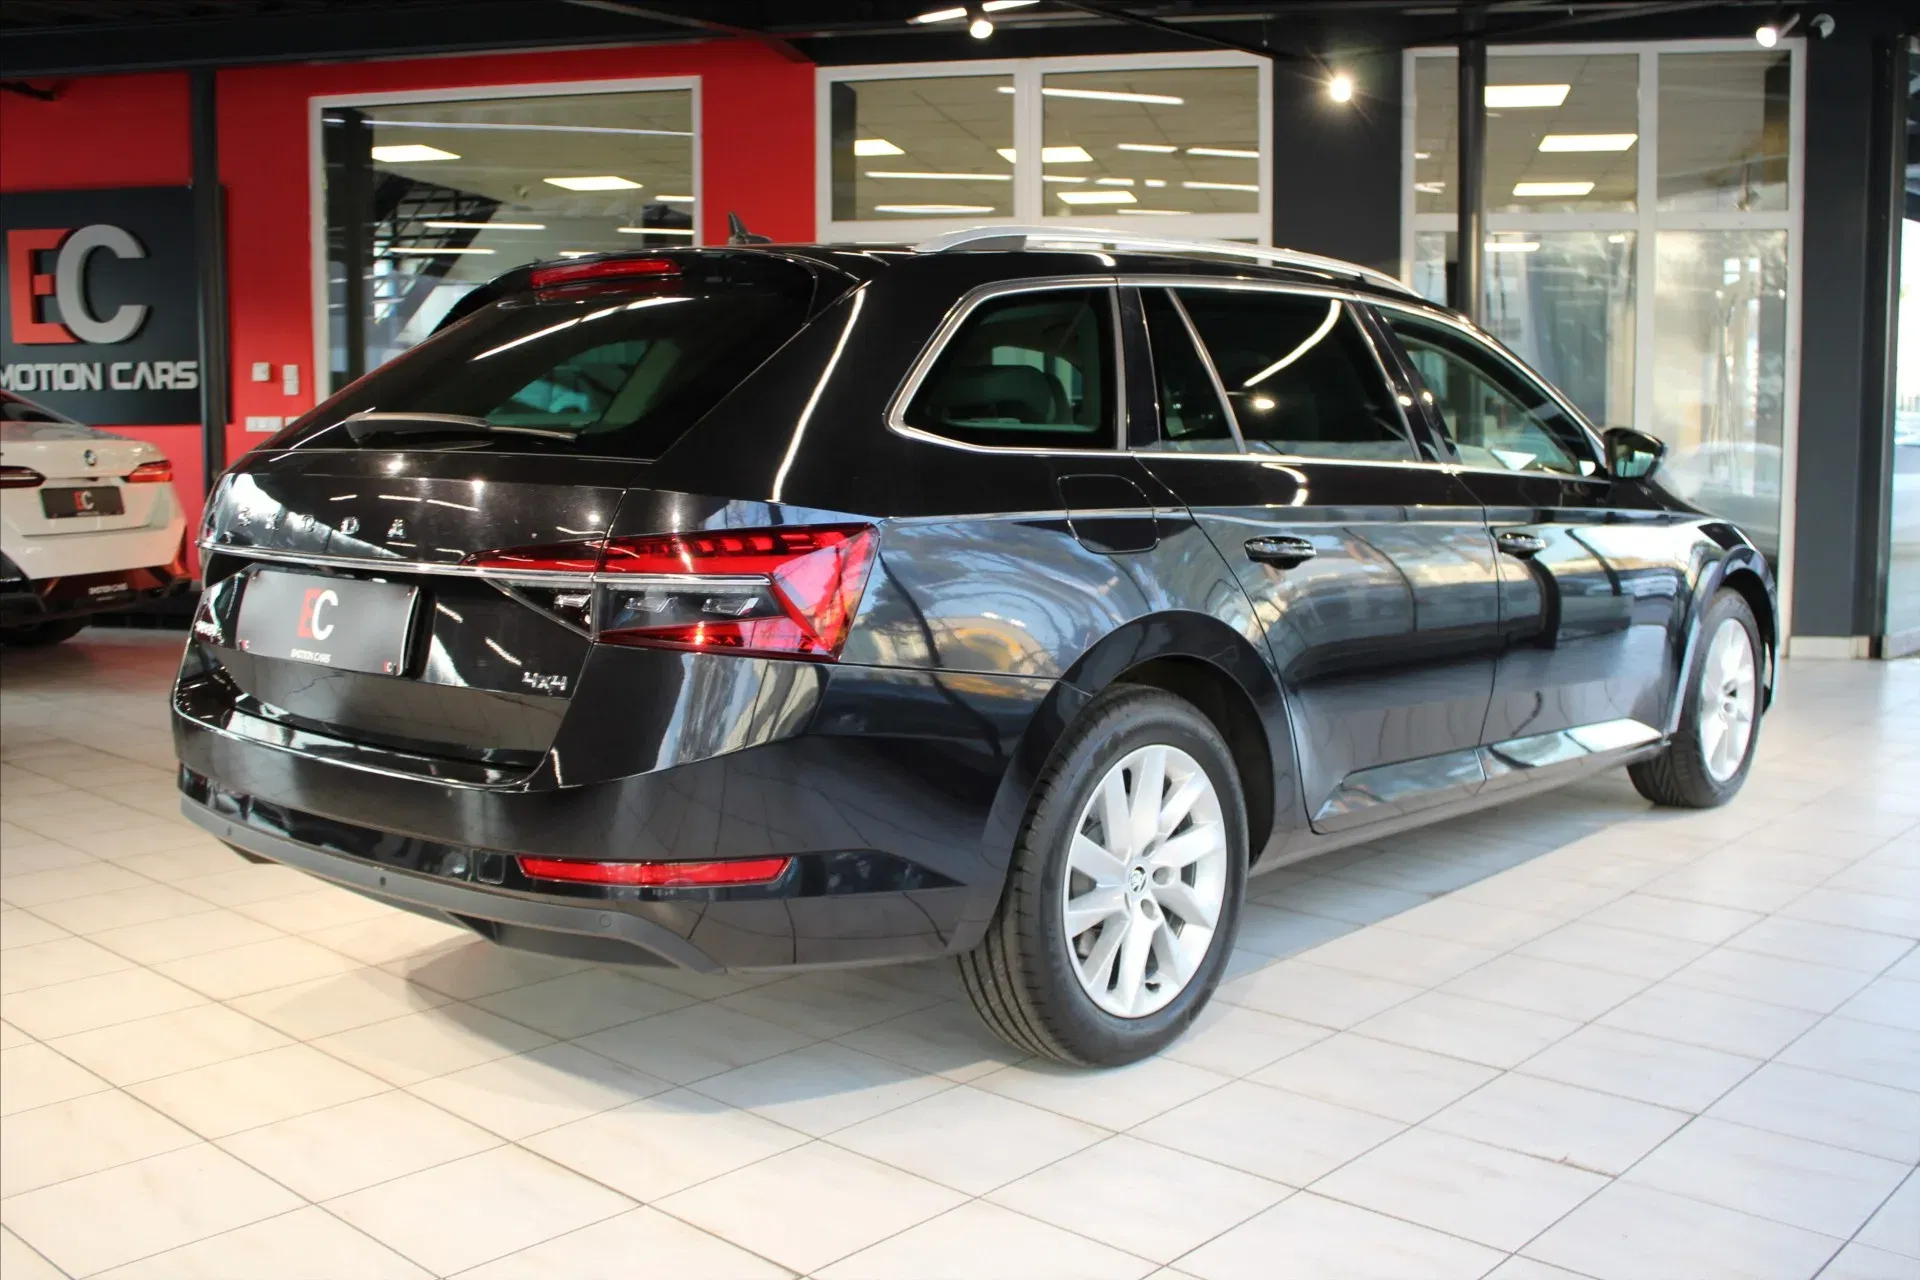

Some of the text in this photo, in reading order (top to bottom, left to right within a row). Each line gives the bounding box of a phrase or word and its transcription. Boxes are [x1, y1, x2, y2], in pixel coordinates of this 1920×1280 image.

[7, 224, 148, 344] EC
[110, 361, 199, 390] CARS
[297, 588, 339, 641] EC
